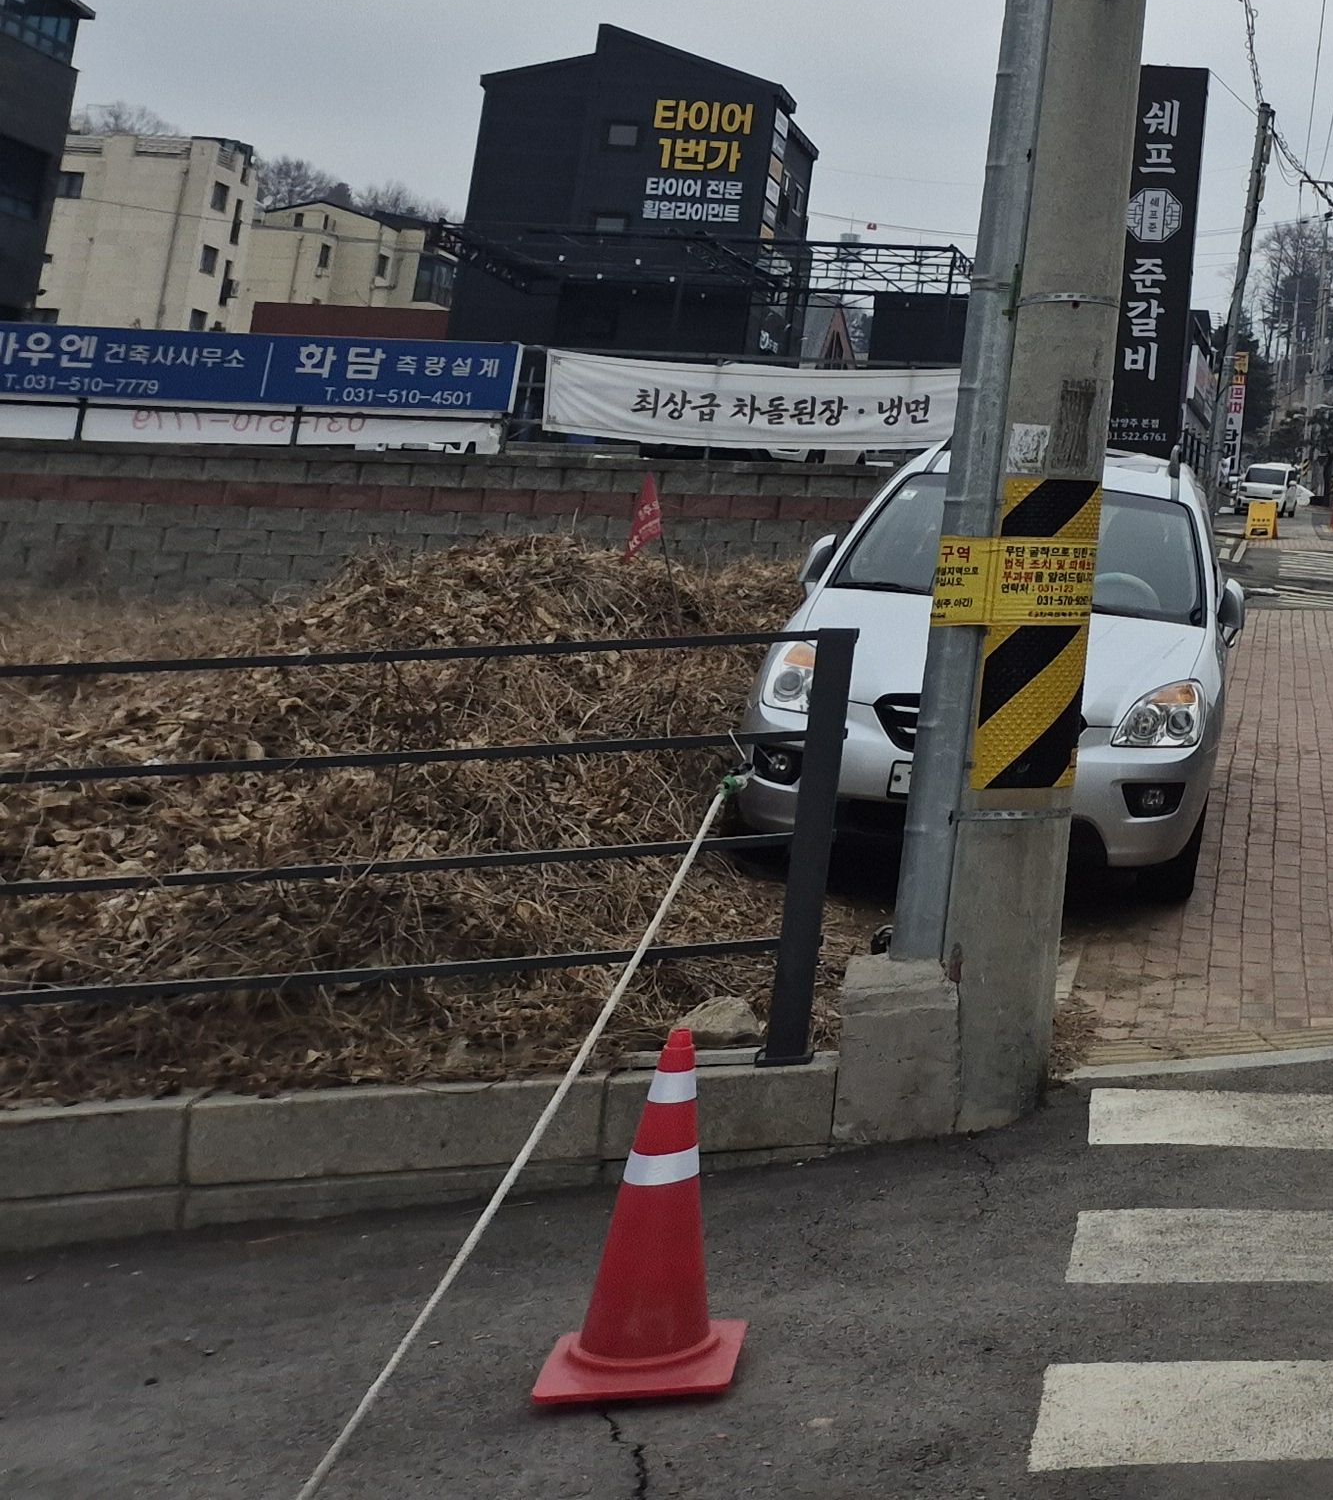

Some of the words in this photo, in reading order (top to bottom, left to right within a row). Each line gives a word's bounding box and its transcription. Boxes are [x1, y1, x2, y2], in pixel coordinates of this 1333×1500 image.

[653, 99, 754, 135] 타이어
[1139, 99, 1180, 174] 쉐프
[658, 138, 742, 173] 1번가
[645, 177, 702, 198] 타이어
[706, 180, 743, 199] 전문
[642, 200, 740, 222] 휠얼라이먼트
[1124, 258, 1168, 381] 준갈비
[104, 343, 245, 368] 건축사사무소
[295, 343, 386, 381] 화담
[396, 355, 500, 378] 측량설계
[630, 387, 721, 422] 최상급
[729, 394, 848, 426] 차돌된장
[877, 394, 931, 426] 냉면
[941, 545, 971, 563] 구역
